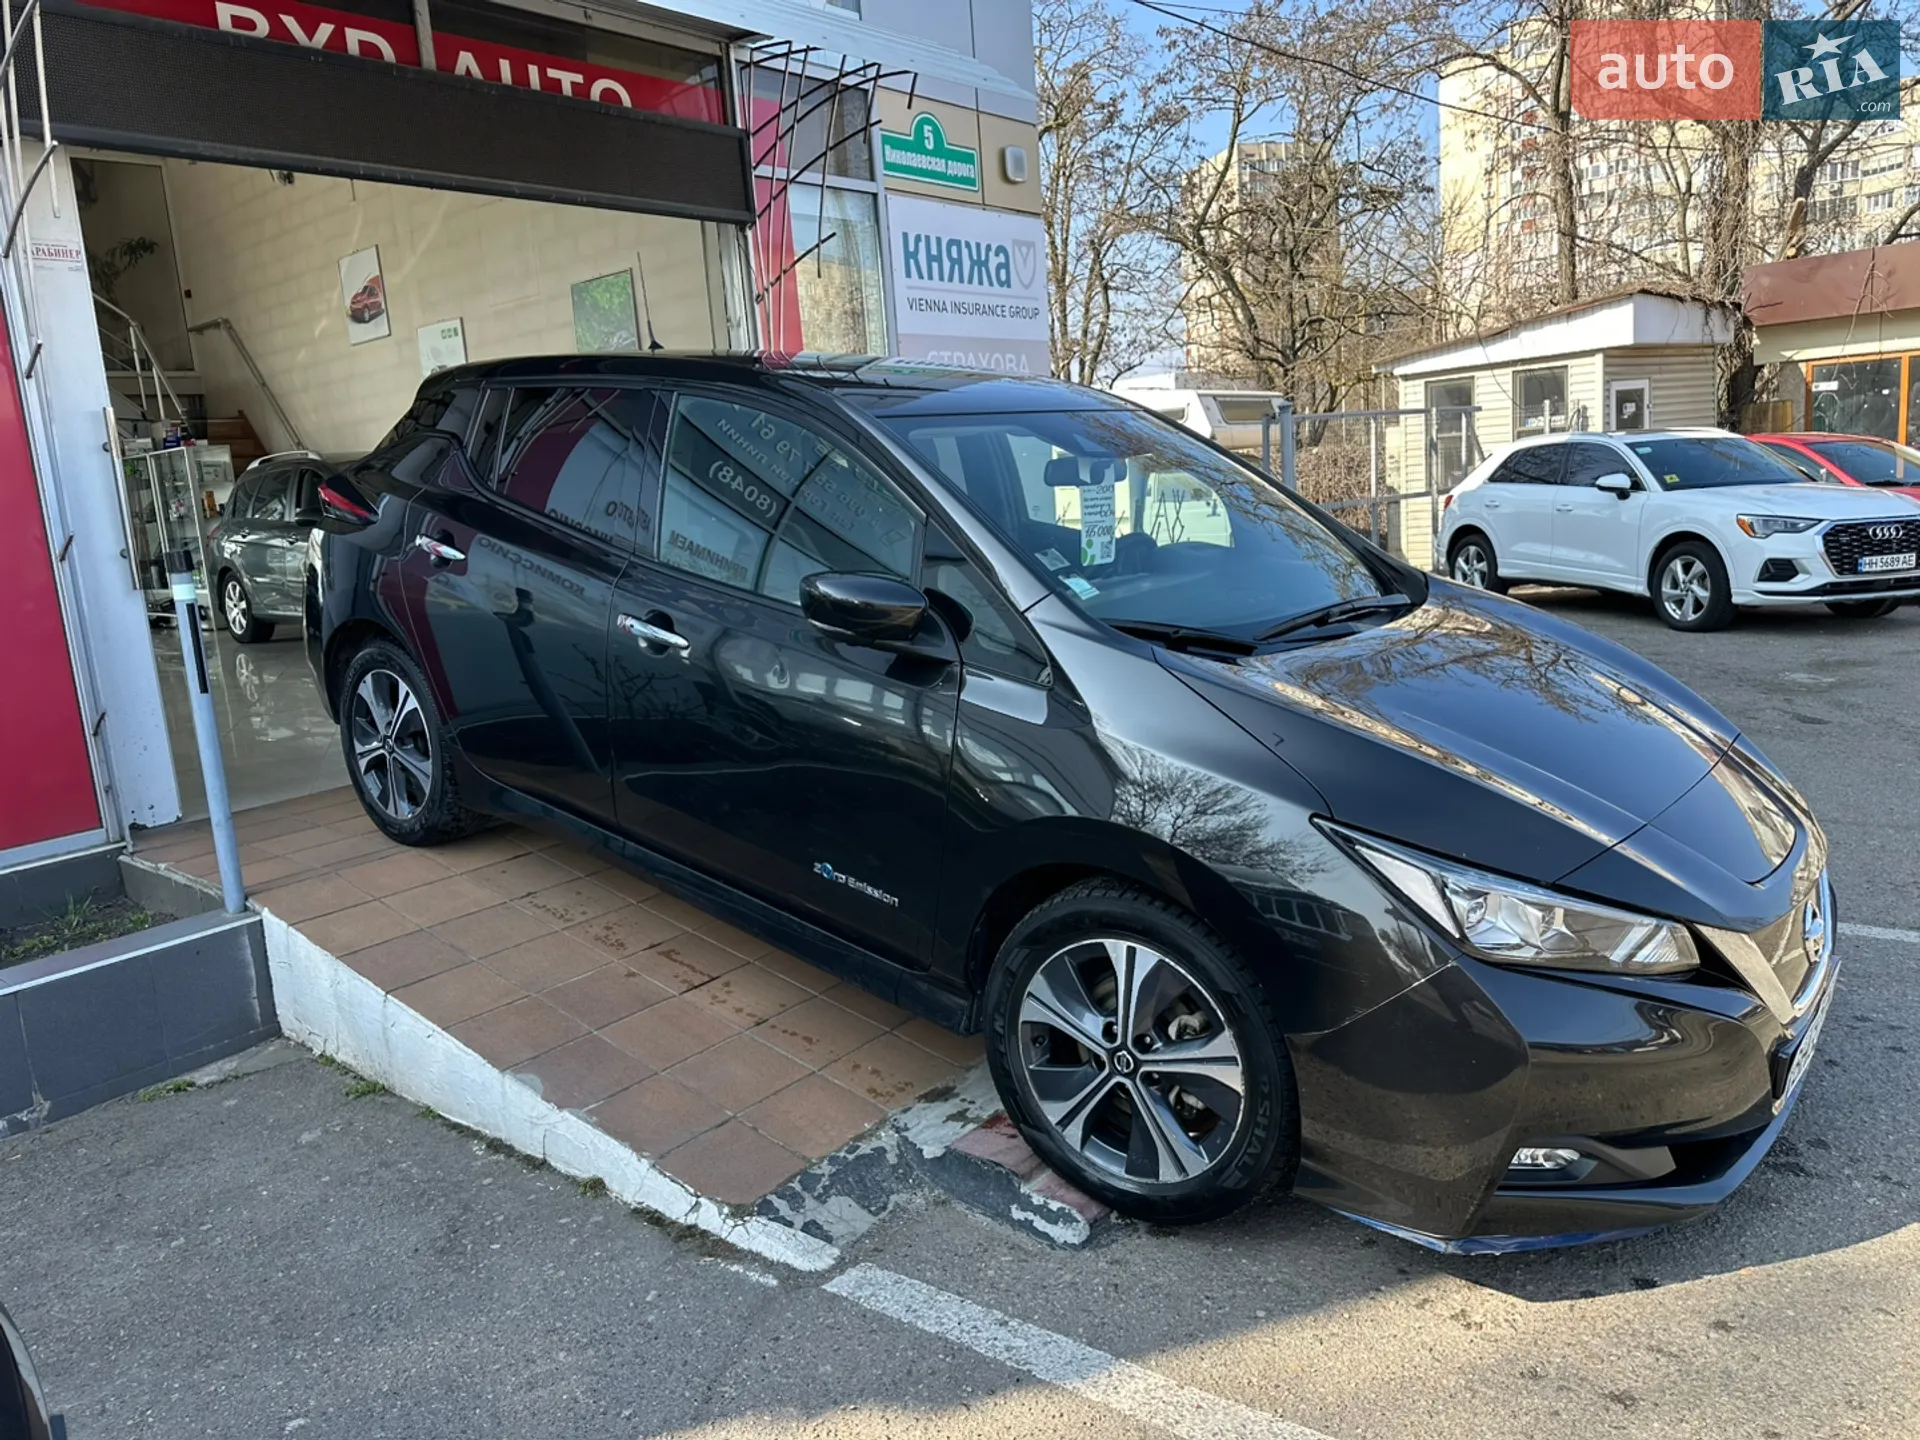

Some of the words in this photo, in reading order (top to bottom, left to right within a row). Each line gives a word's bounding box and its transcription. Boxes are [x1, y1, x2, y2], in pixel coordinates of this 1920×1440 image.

[923, 124, 934, 150] 5
[907, 297, 948, 314] VIENNA
[950, 301, 1007, 318] INSURANCE
[1009, 306, 1040, 320] GROUP
